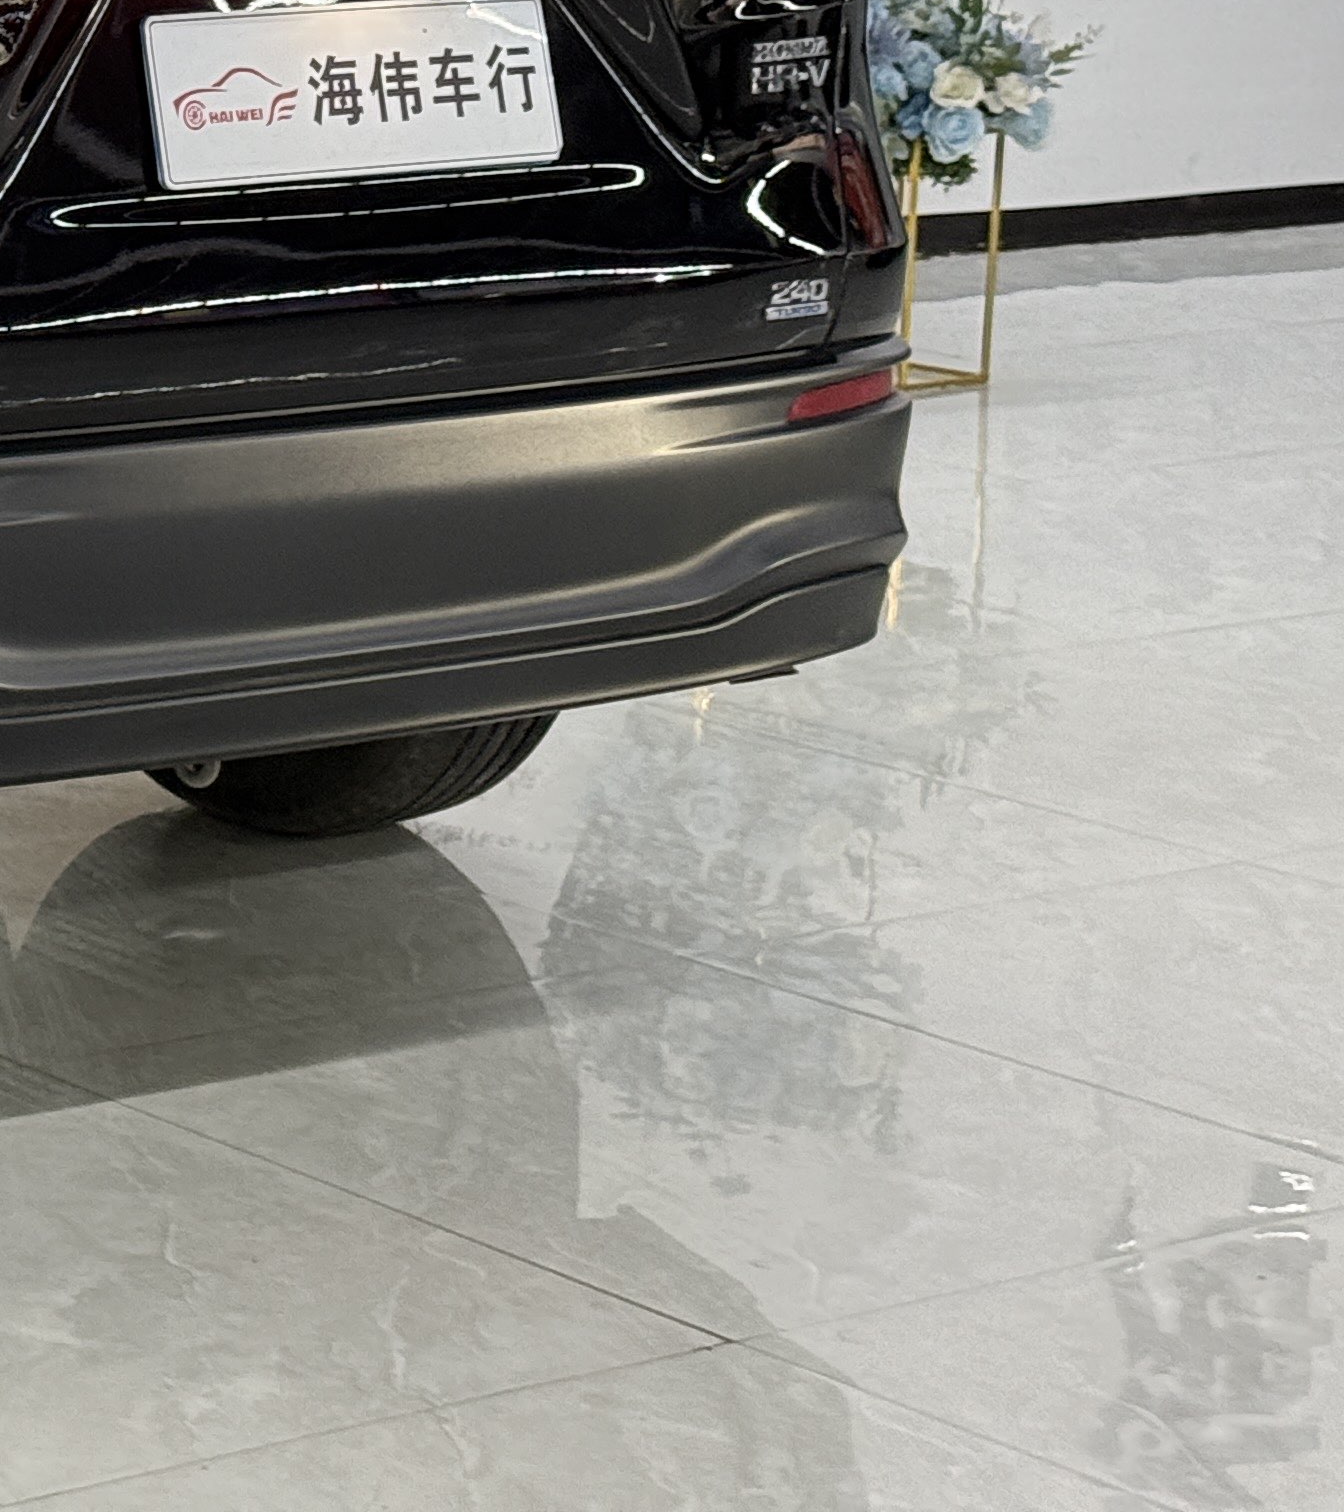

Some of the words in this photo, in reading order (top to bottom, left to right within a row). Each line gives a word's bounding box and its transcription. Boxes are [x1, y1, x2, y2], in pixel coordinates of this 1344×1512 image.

[308, 44, 537, 126] 海伟车行
[750, 59, 831, 95] HR-V
[771, 278, 830, 305] 240
